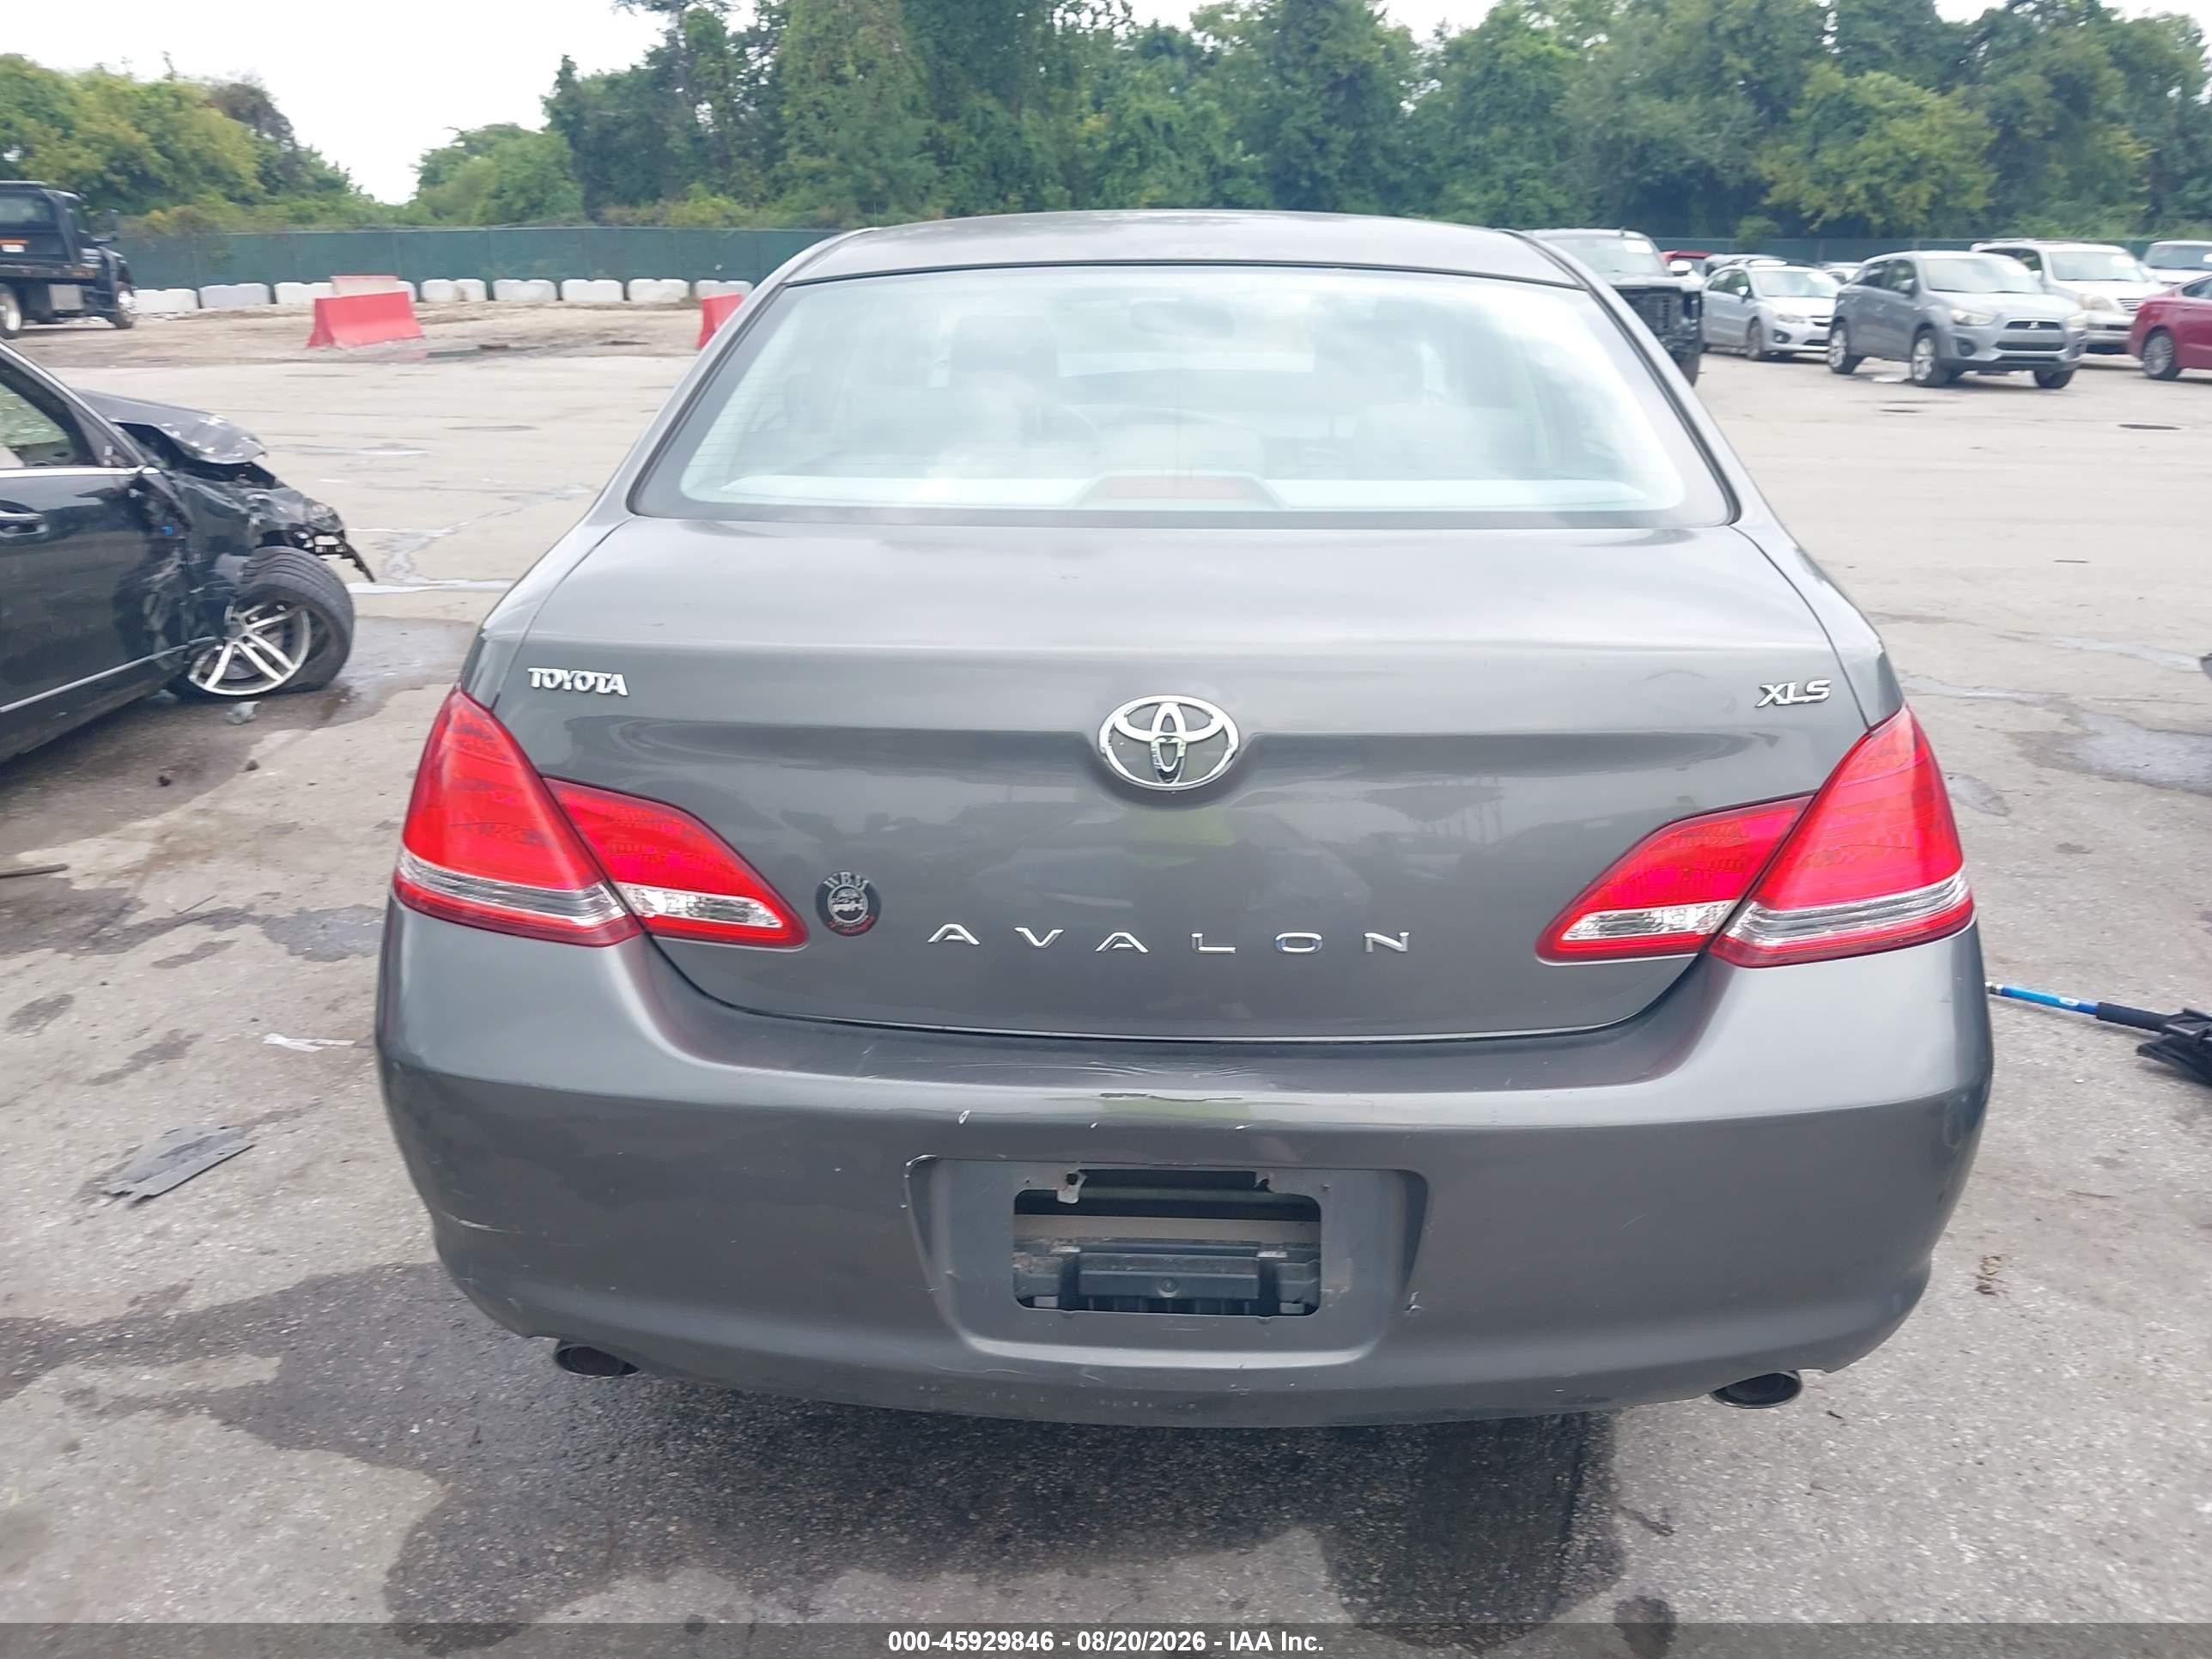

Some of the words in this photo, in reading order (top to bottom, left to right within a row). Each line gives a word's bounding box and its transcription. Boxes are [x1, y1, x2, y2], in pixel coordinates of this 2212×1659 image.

[527, 667, 629, 696] TOYOTA
[1755, 679, 1832, 708] XLS
[927, 923, 1411, 955] AVALON
